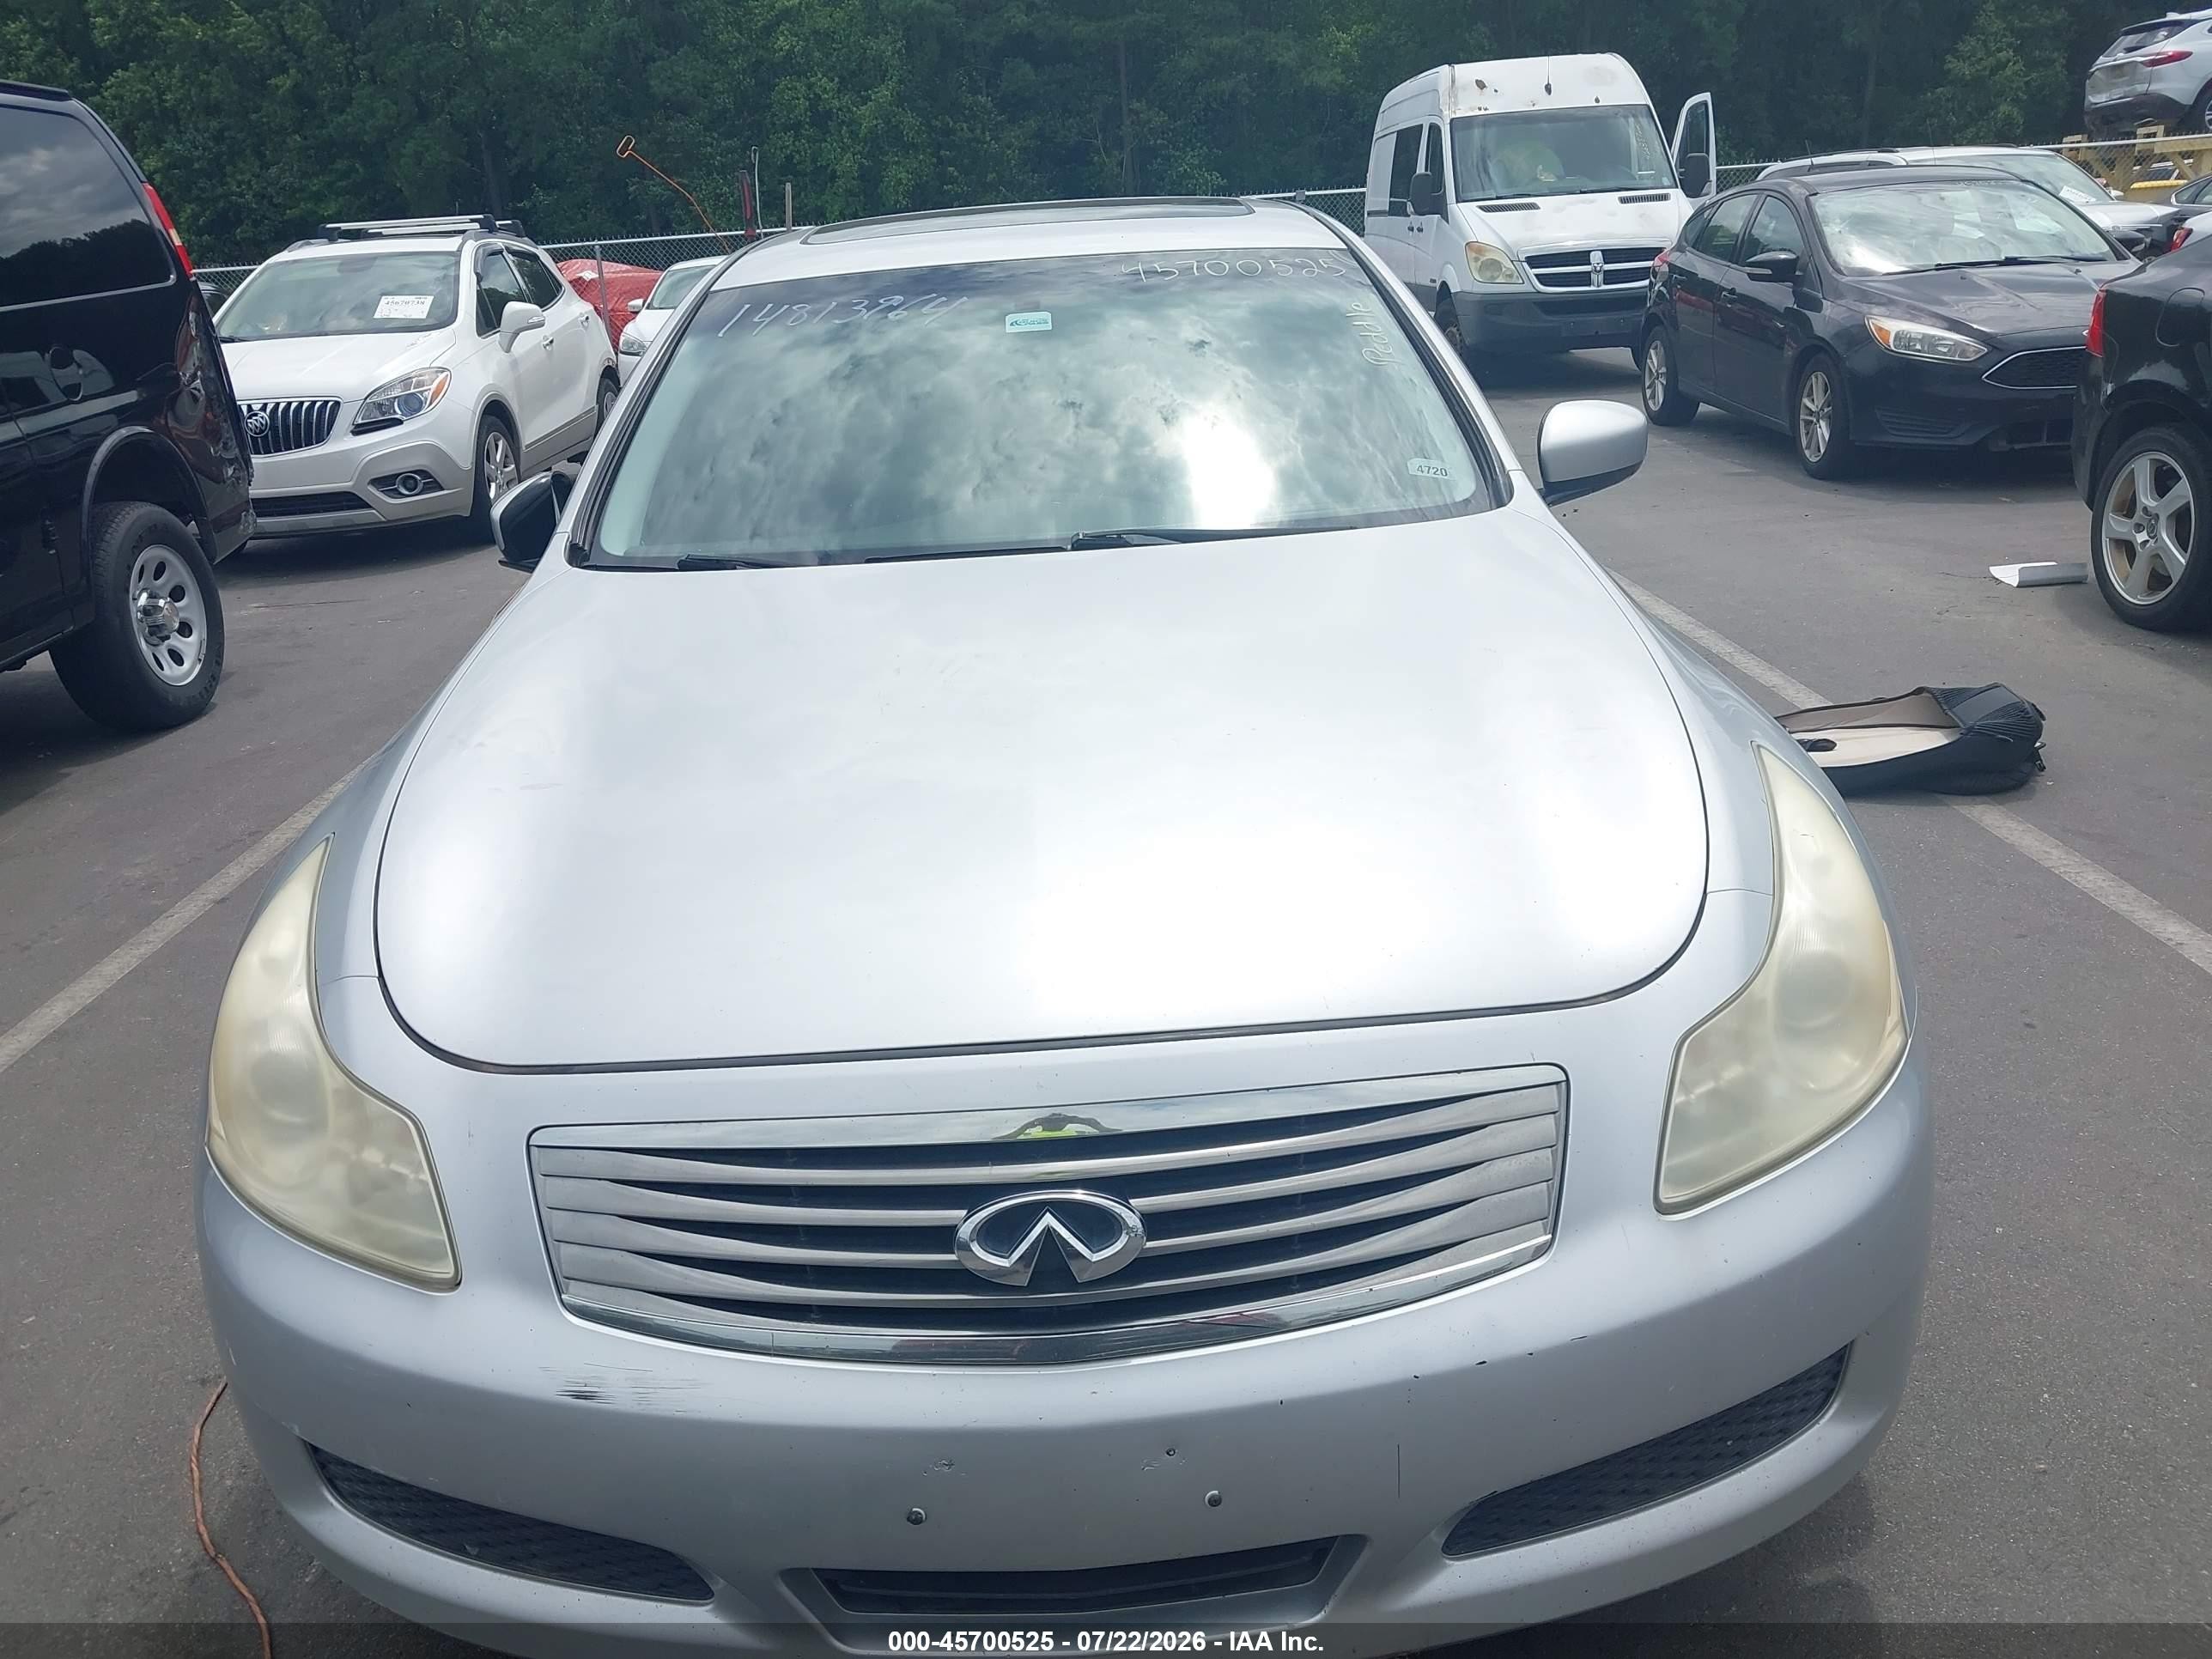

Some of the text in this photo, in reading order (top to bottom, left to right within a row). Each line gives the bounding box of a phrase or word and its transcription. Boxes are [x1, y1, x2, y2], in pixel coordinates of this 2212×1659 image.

[1121, 259, 1346, 282] 45700525
[1346, 303, 1403, 365] Peddle
[1416, 465, 1449, 477] 4720
